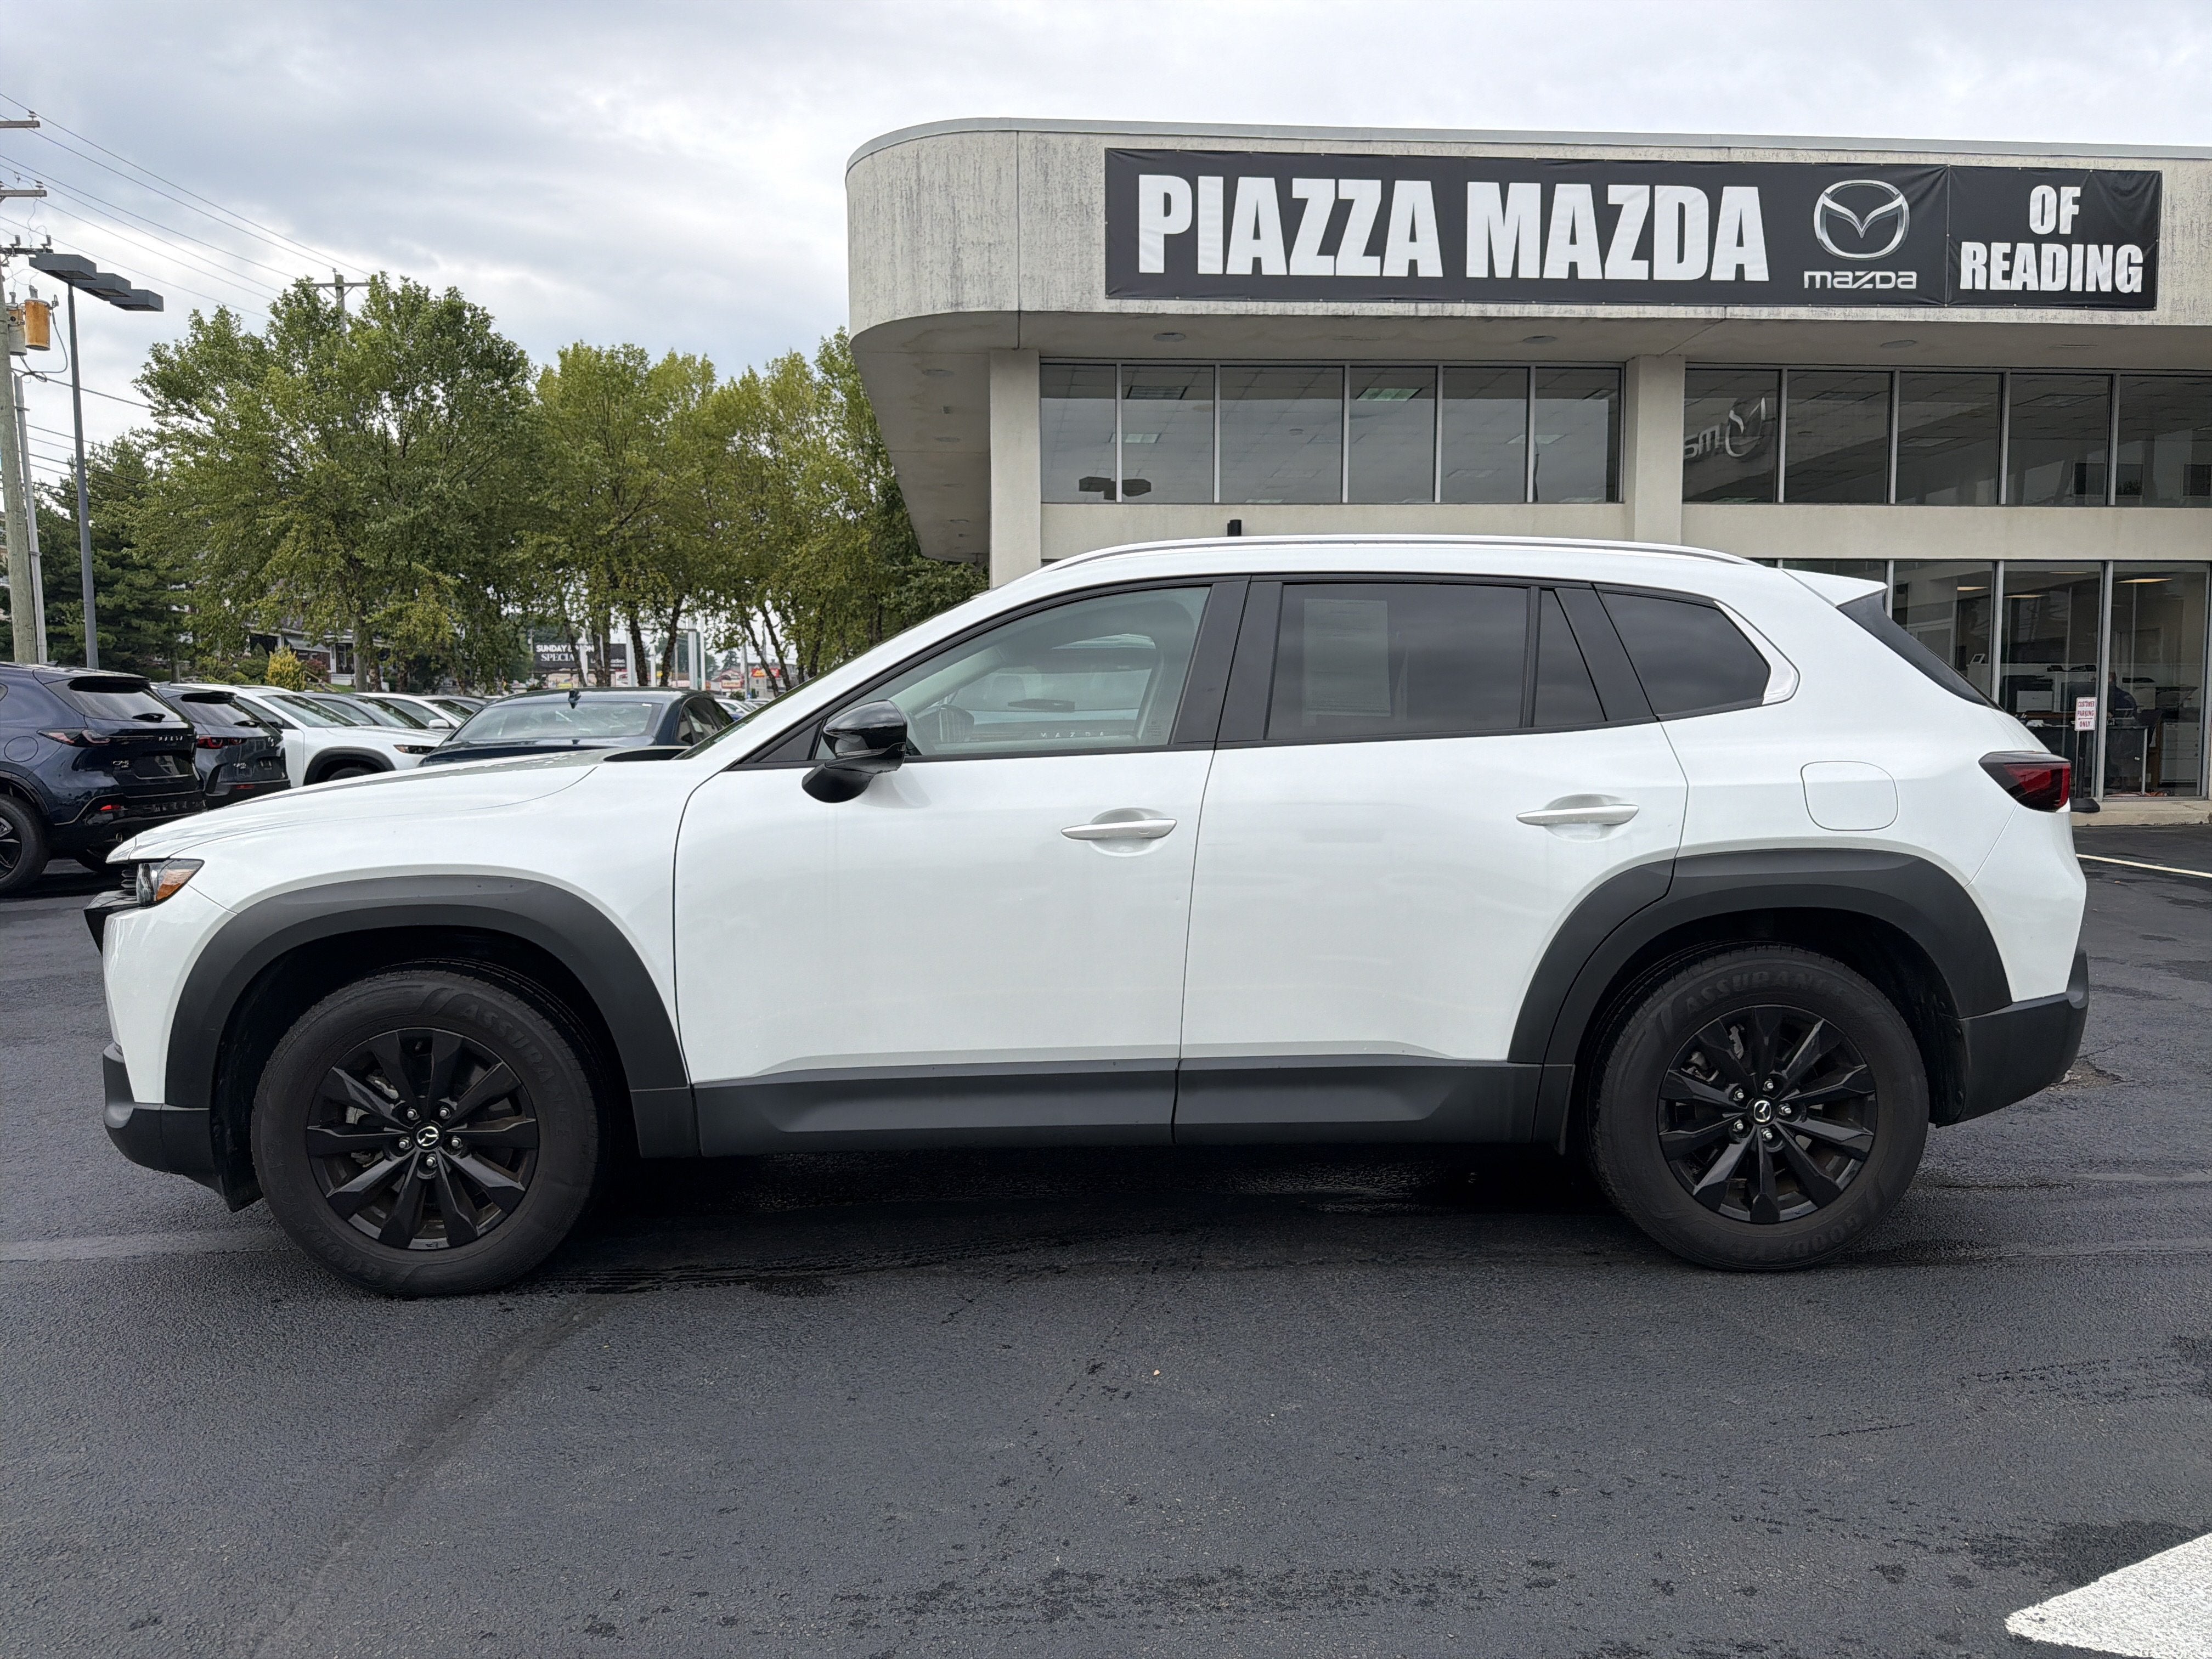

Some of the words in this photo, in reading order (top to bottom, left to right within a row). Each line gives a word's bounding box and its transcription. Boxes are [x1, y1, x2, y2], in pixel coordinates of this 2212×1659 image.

[1138, 174, 1444, 278] PIAZZA
[1466, 182, 1769, 281] MAZDA
[2029, 185, 2081, 235] OF
[1960, 241, 2144, 294] READING
[536, 644, 567, 652] SUNDAY
